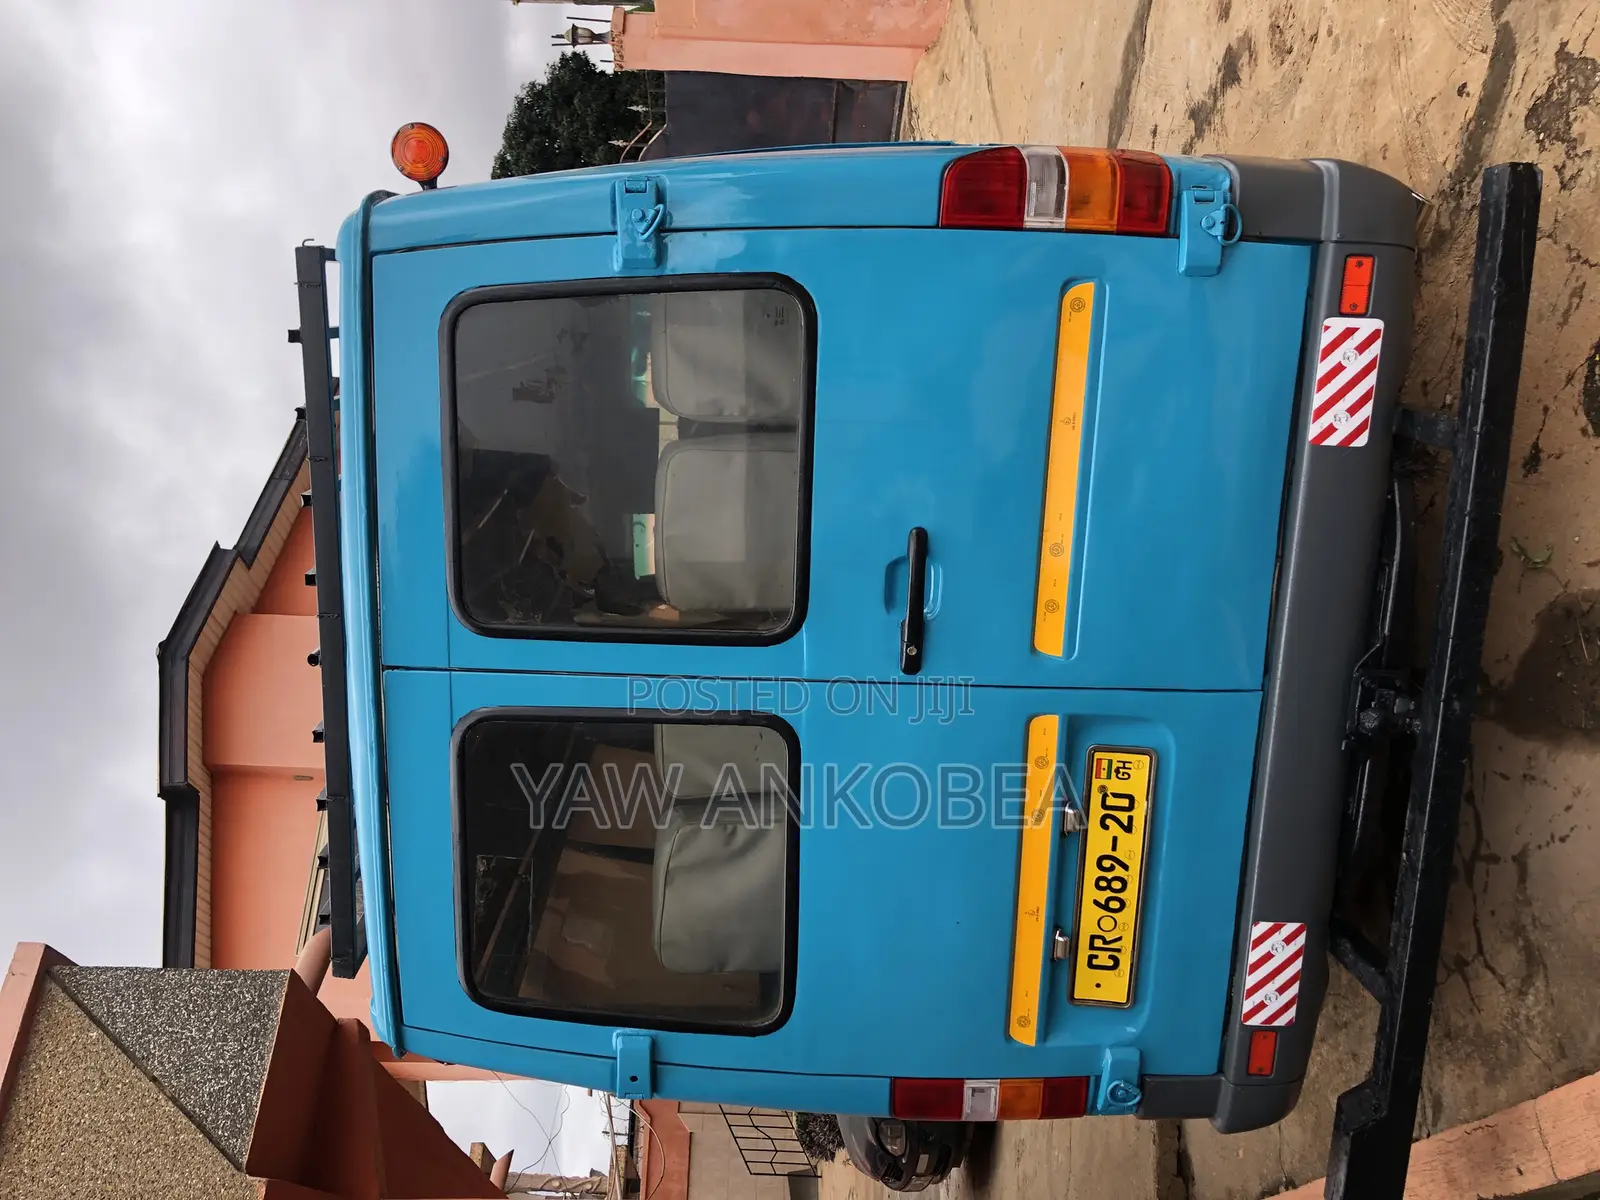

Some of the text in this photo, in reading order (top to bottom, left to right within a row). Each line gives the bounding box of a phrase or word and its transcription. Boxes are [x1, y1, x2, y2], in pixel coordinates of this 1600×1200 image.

[1114, 760, 1133, 781] GH
[1086, 792, 1136, 971] CR 689-20
